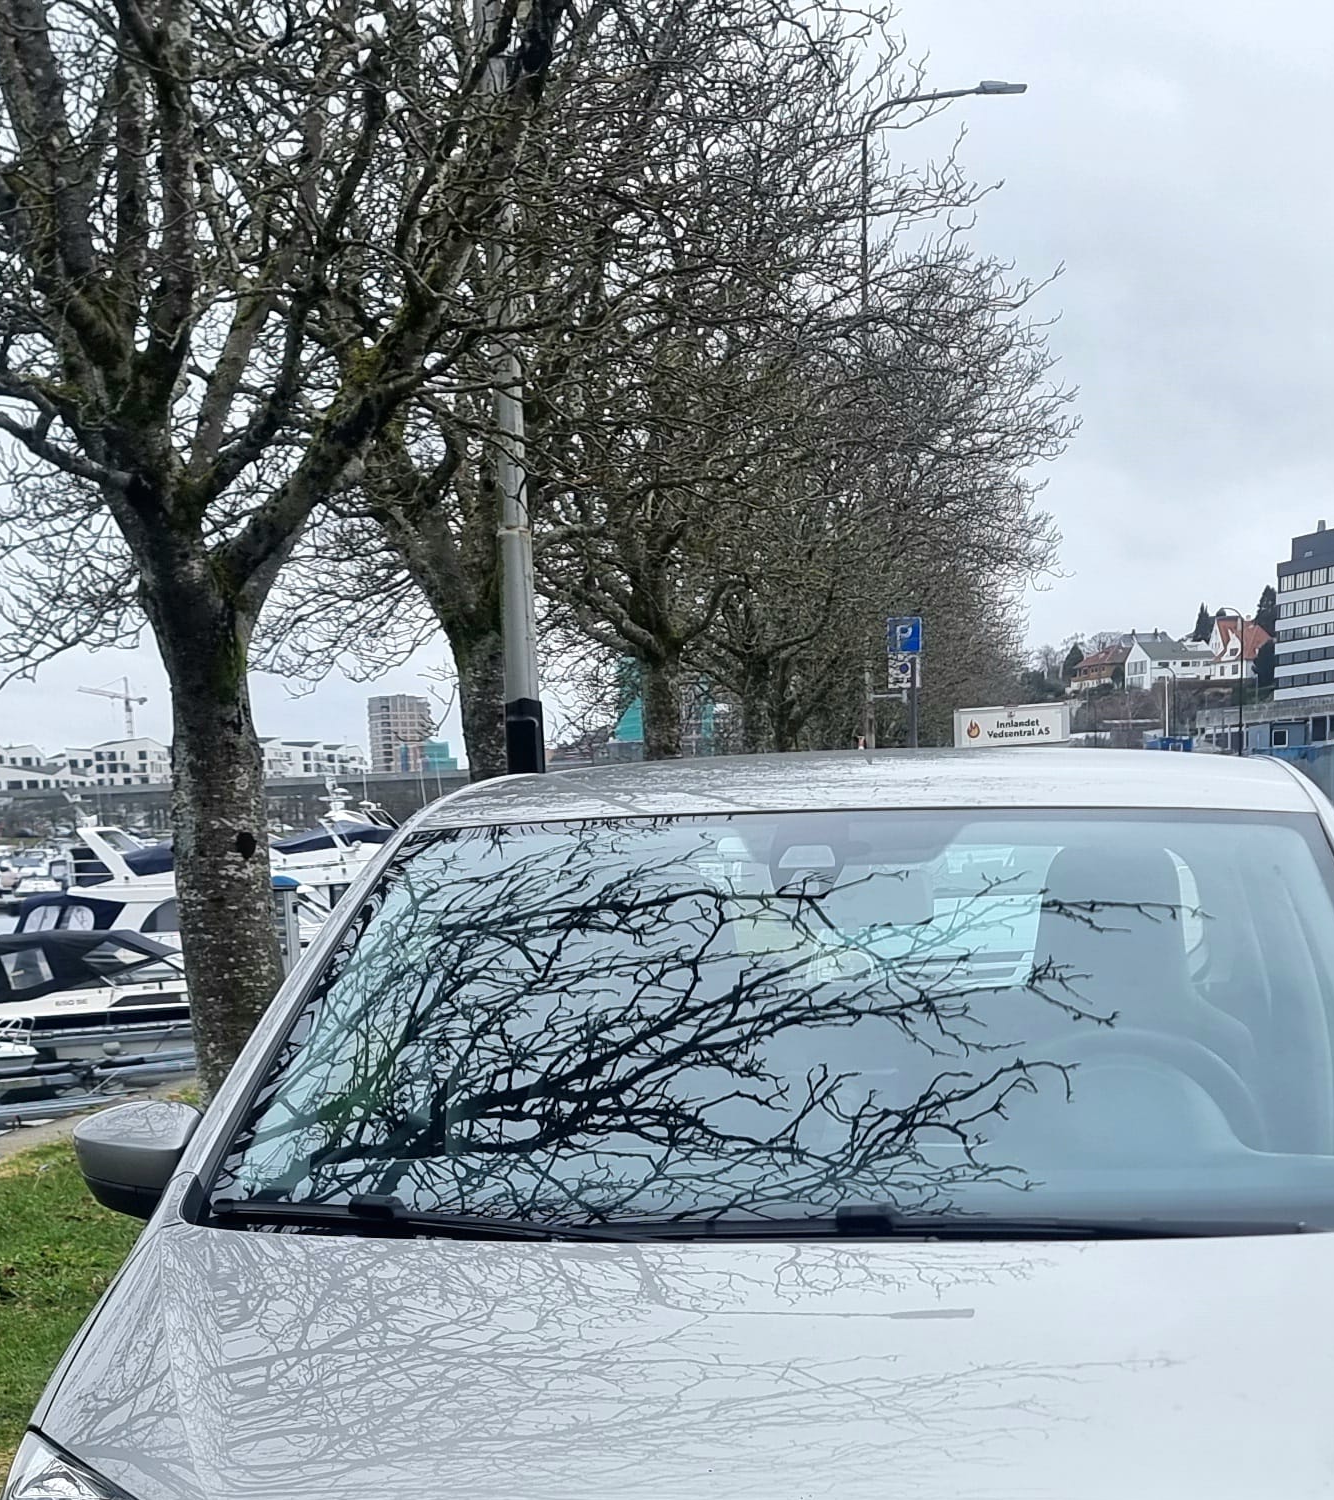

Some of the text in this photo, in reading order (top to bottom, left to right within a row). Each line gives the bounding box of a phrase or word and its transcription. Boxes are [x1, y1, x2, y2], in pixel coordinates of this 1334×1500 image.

[896, 625, 913, 650] P
[996, 719, 1039, 728] Innlandet
[987, 727, 1050, 738] Vedsentral AS
